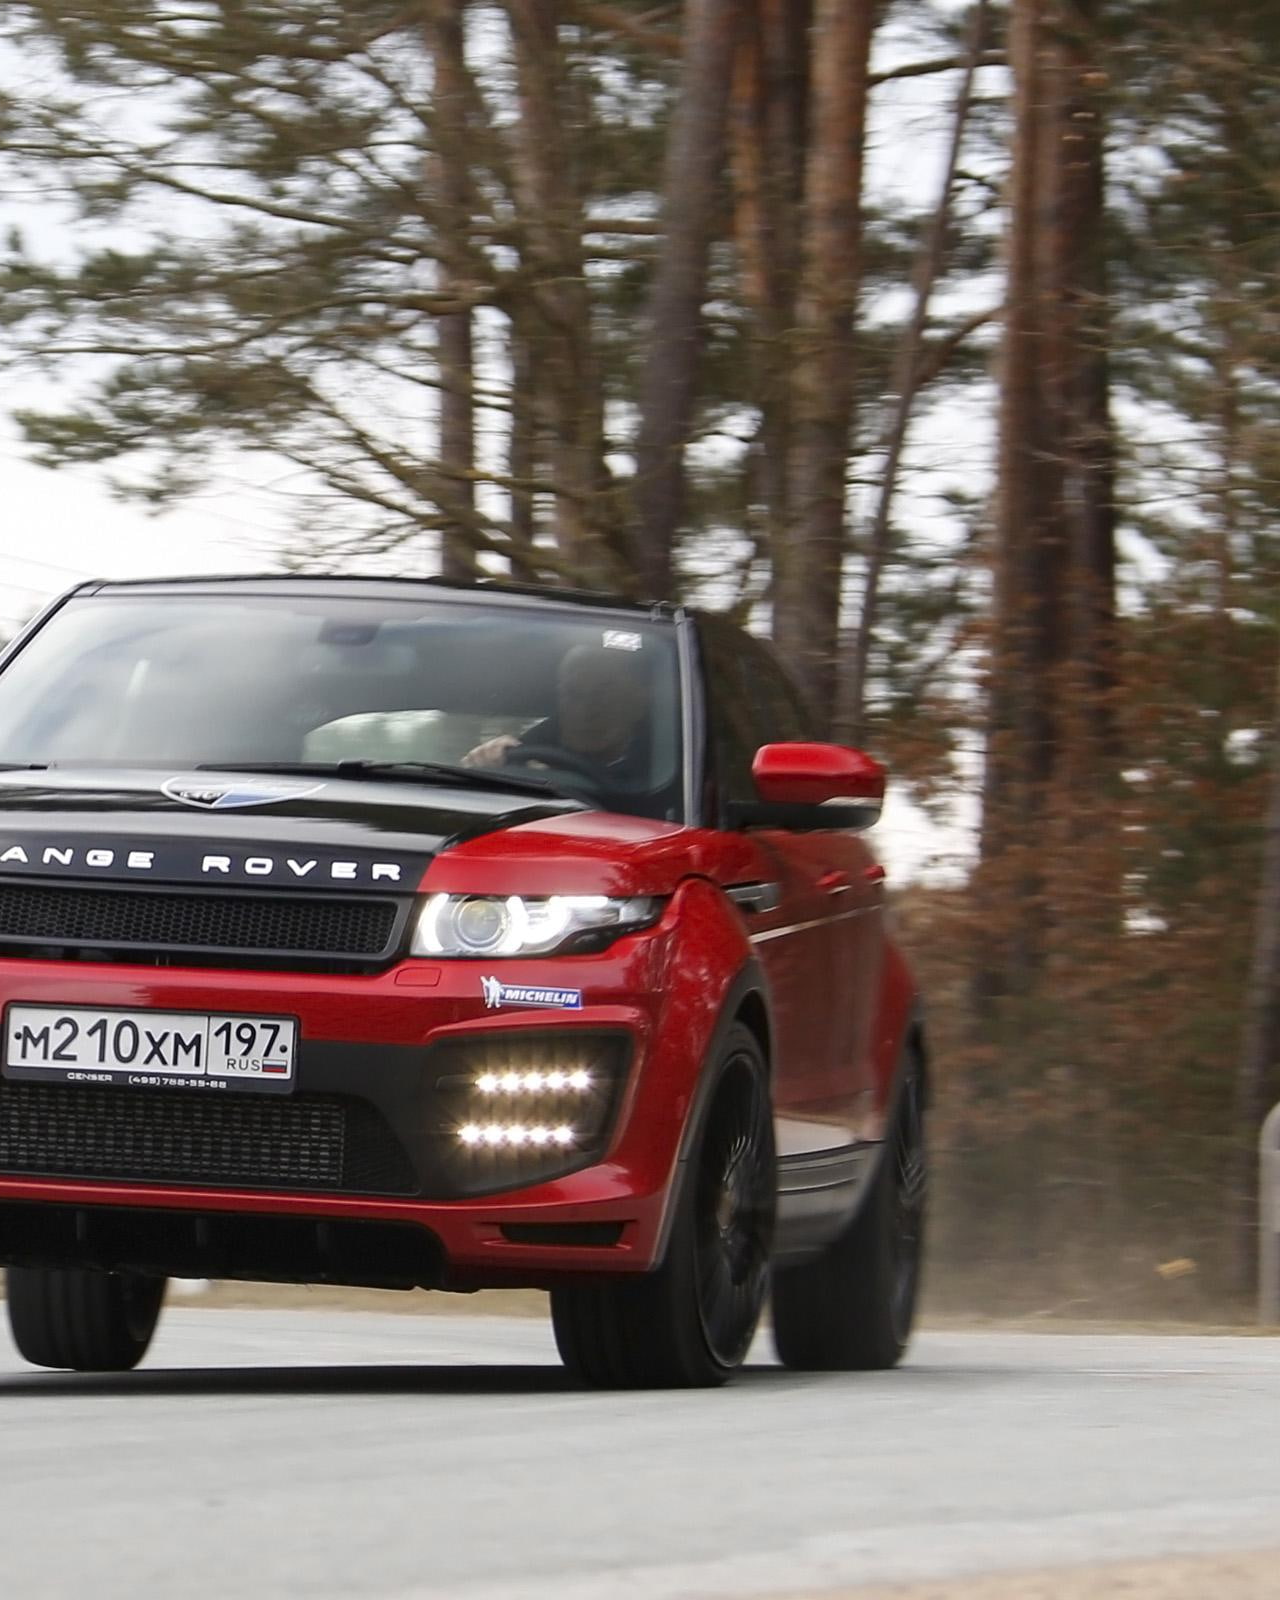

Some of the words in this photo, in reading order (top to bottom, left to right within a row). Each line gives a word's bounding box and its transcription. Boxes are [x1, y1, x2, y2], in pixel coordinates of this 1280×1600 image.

[202, 855, 401, 881] ROVER
[505, 989, 578, 1004] MICHELIN
[214, 1021, 280, 1057] 197
[226, 1058, 260, 1072] RUS
[67, 1072, 113, 1082] GENSER
